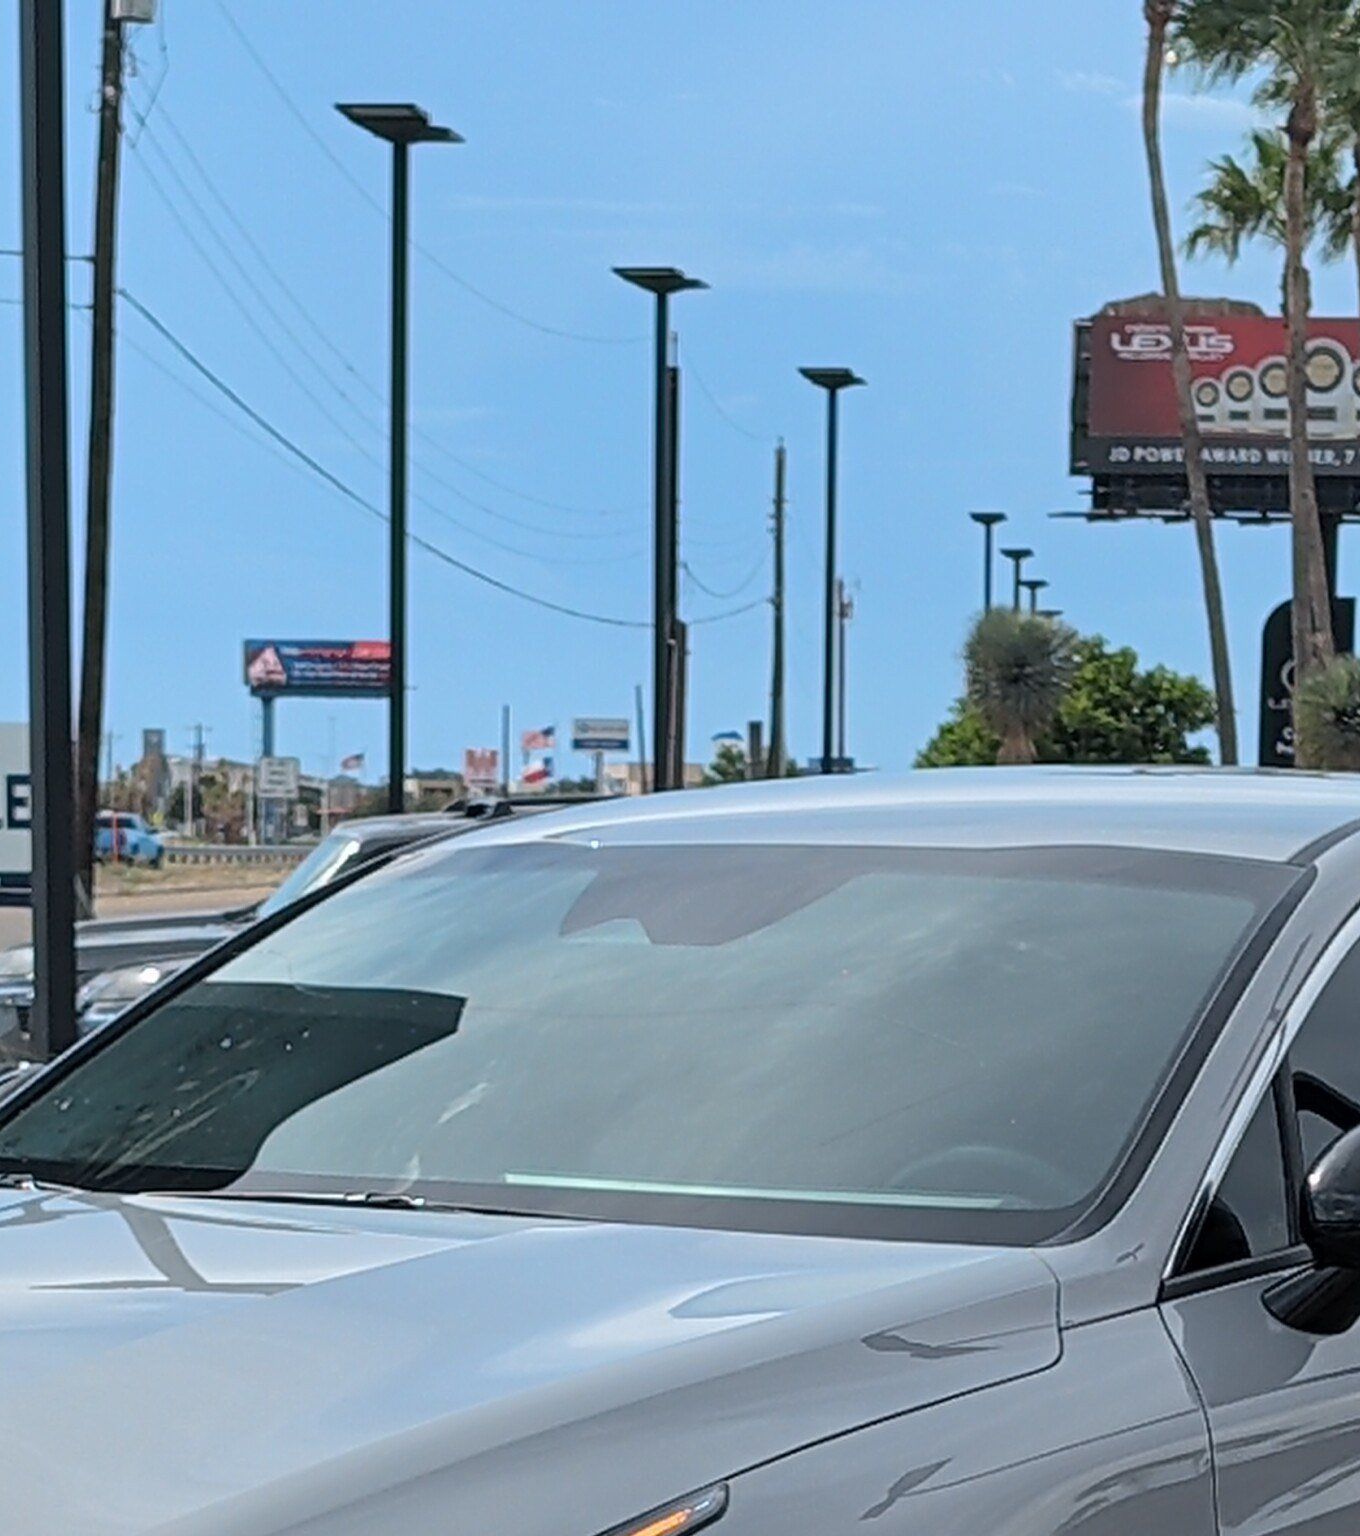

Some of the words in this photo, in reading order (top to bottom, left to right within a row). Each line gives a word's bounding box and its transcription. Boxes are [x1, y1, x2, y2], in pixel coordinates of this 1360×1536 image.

[1108, 447, 1131, 463] JD
[1133, 447, 1186, 463] POWE
[1199, 448, 1262, 464] AWARD
[1343, 449, 1356, 466] 7
